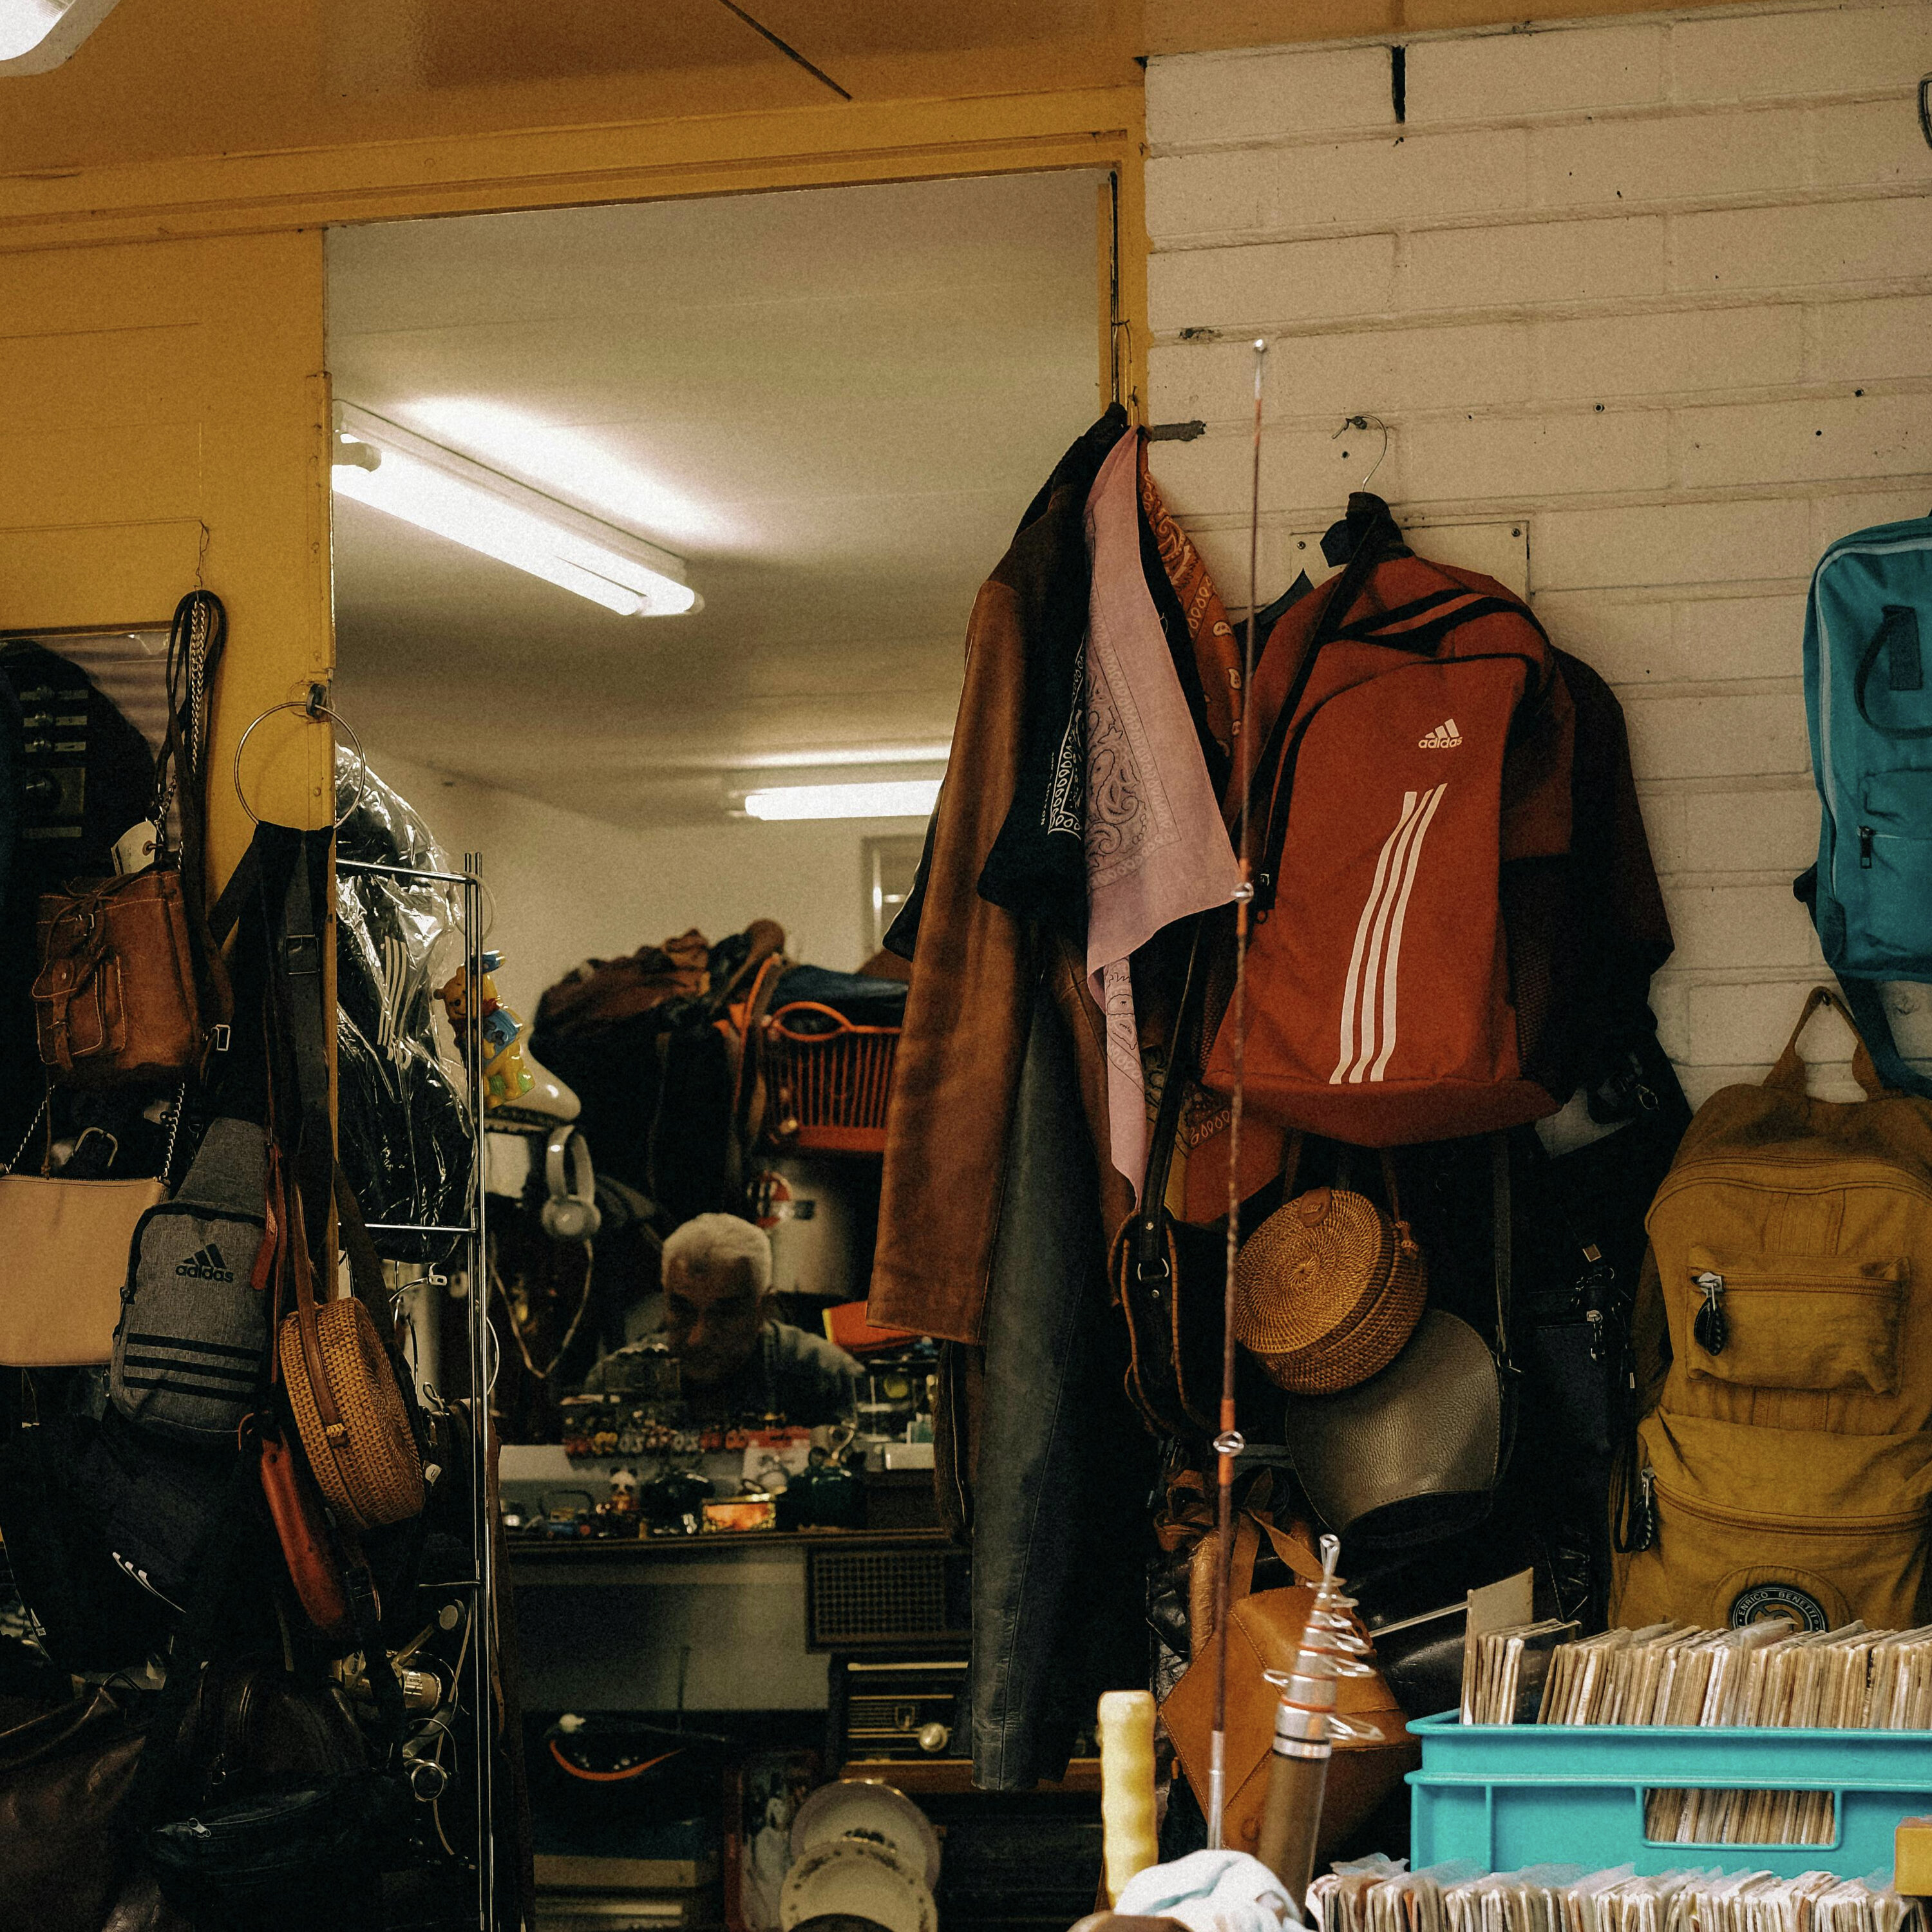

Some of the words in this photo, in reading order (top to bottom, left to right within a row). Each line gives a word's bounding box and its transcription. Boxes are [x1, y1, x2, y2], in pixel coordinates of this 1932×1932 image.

[1418, 737, 1463, 748] adidas
[175, 1264, 234, 1283] adidas
[1739, 1592, 1768, 1616] ENRICO
[1778, 1592, 1817, 1618] BENETTI
